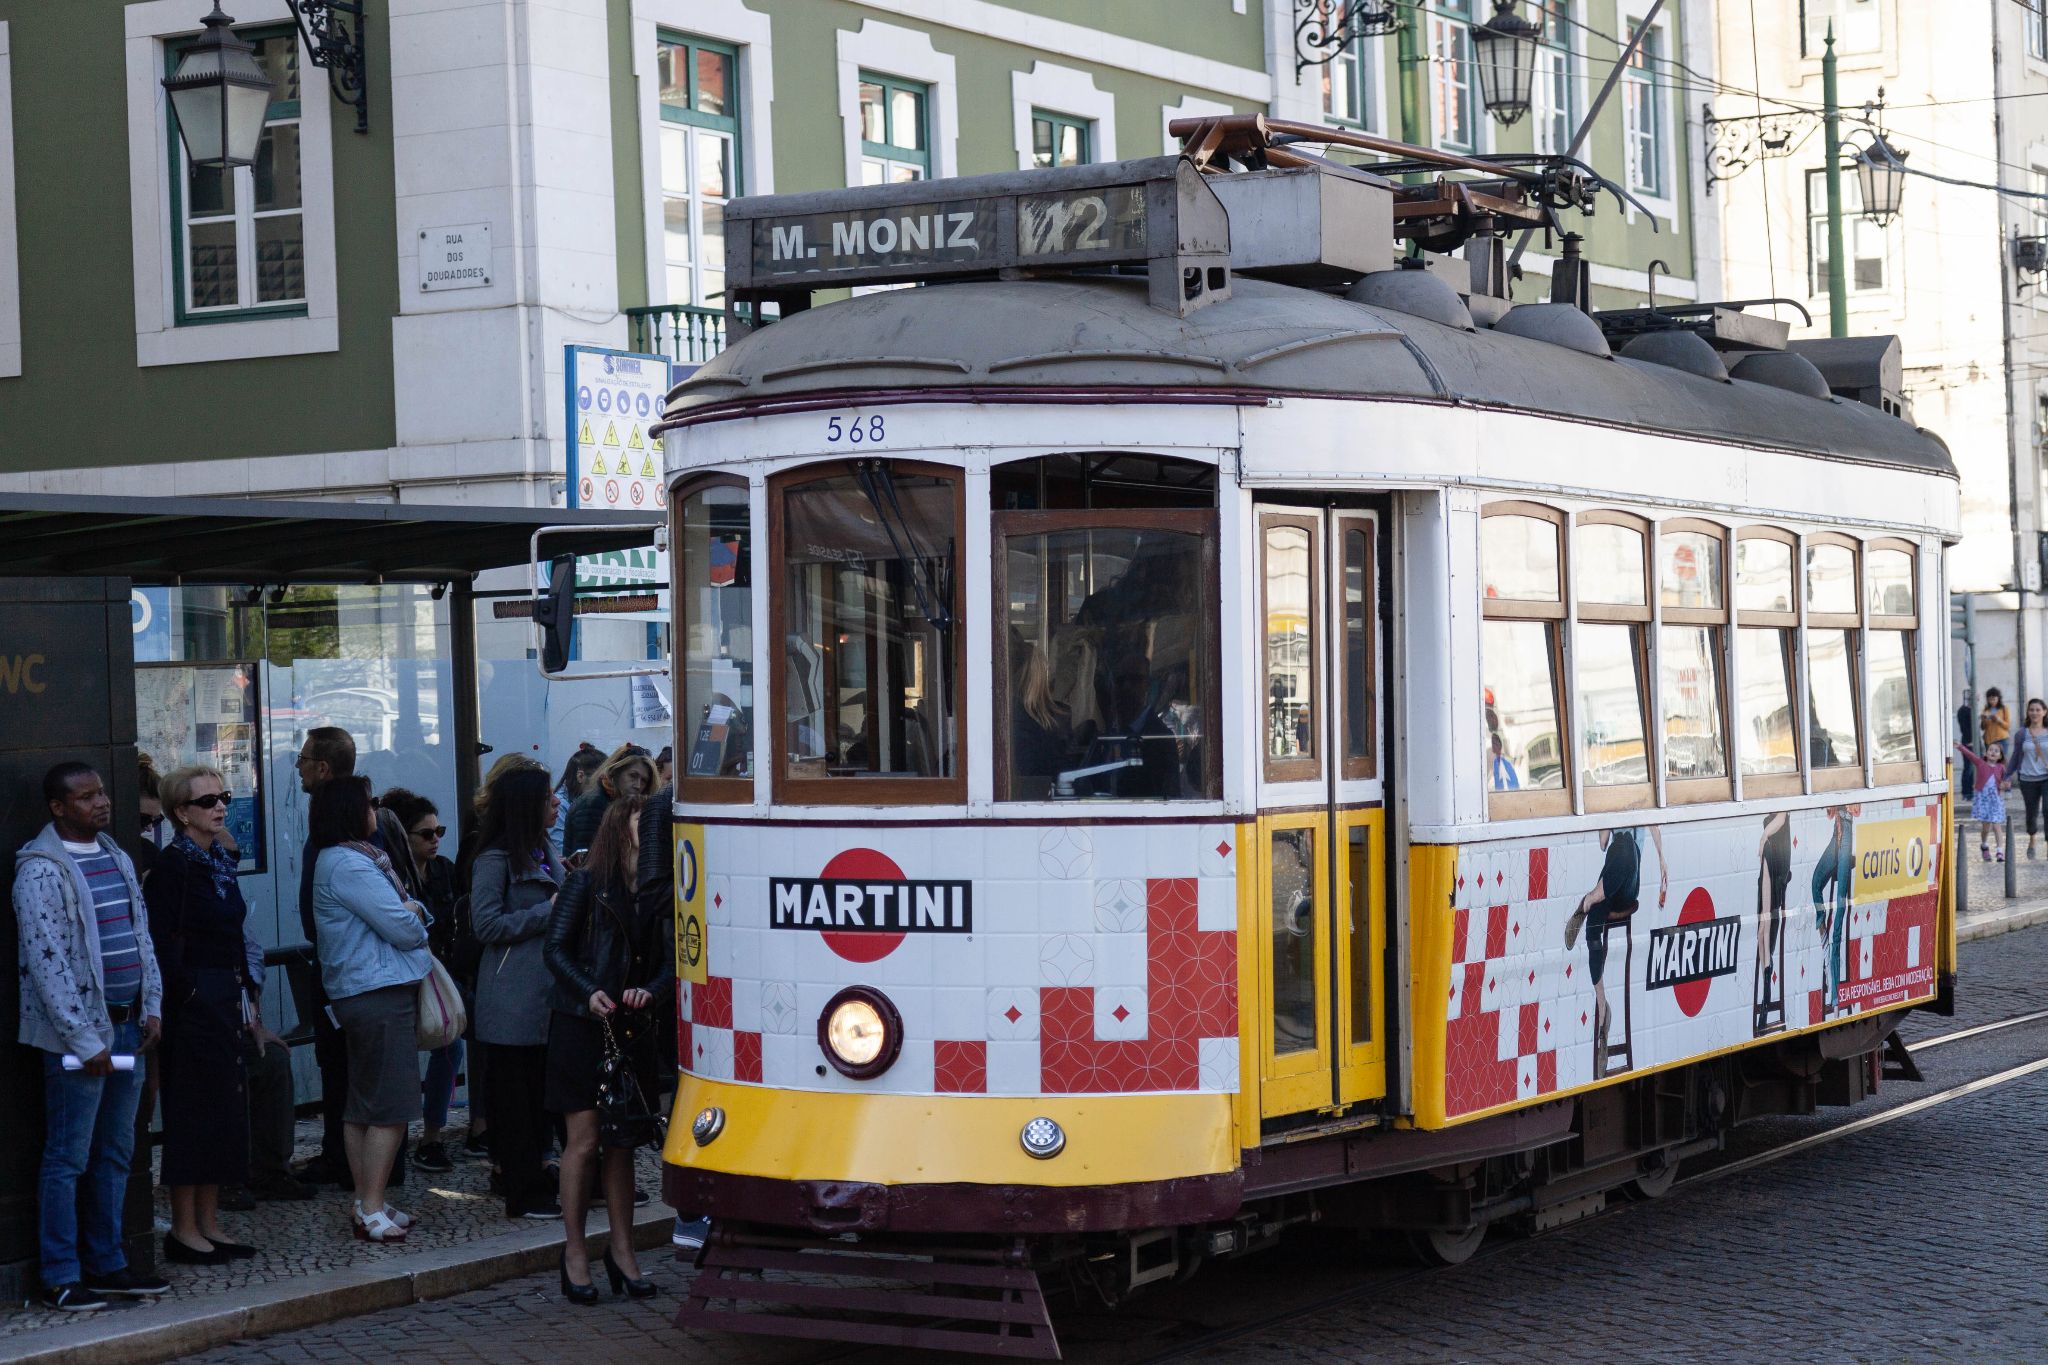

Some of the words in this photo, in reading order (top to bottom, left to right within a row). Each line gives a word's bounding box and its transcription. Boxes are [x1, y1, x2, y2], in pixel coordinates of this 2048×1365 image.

[446, 234, 463, 245] RUA
[771, 224, 818, 262] M.
[831, 211, 976, 257] MONIZ
[447, 252, 464, 263] DOS
[427, 267, 485, 282] DOURADORES
[827, 414, 885, 443] 568
[1863, 837, 1900, 880] carris
[775, 883, 963, 928] MARTINI
[1650, 922, 1738, 984] MARTINI
[1839, 987, 1851, 1003] SEJA
[1882, 976, 1895, 992] BEBA
[1895, 973, 1906, 988] COM
